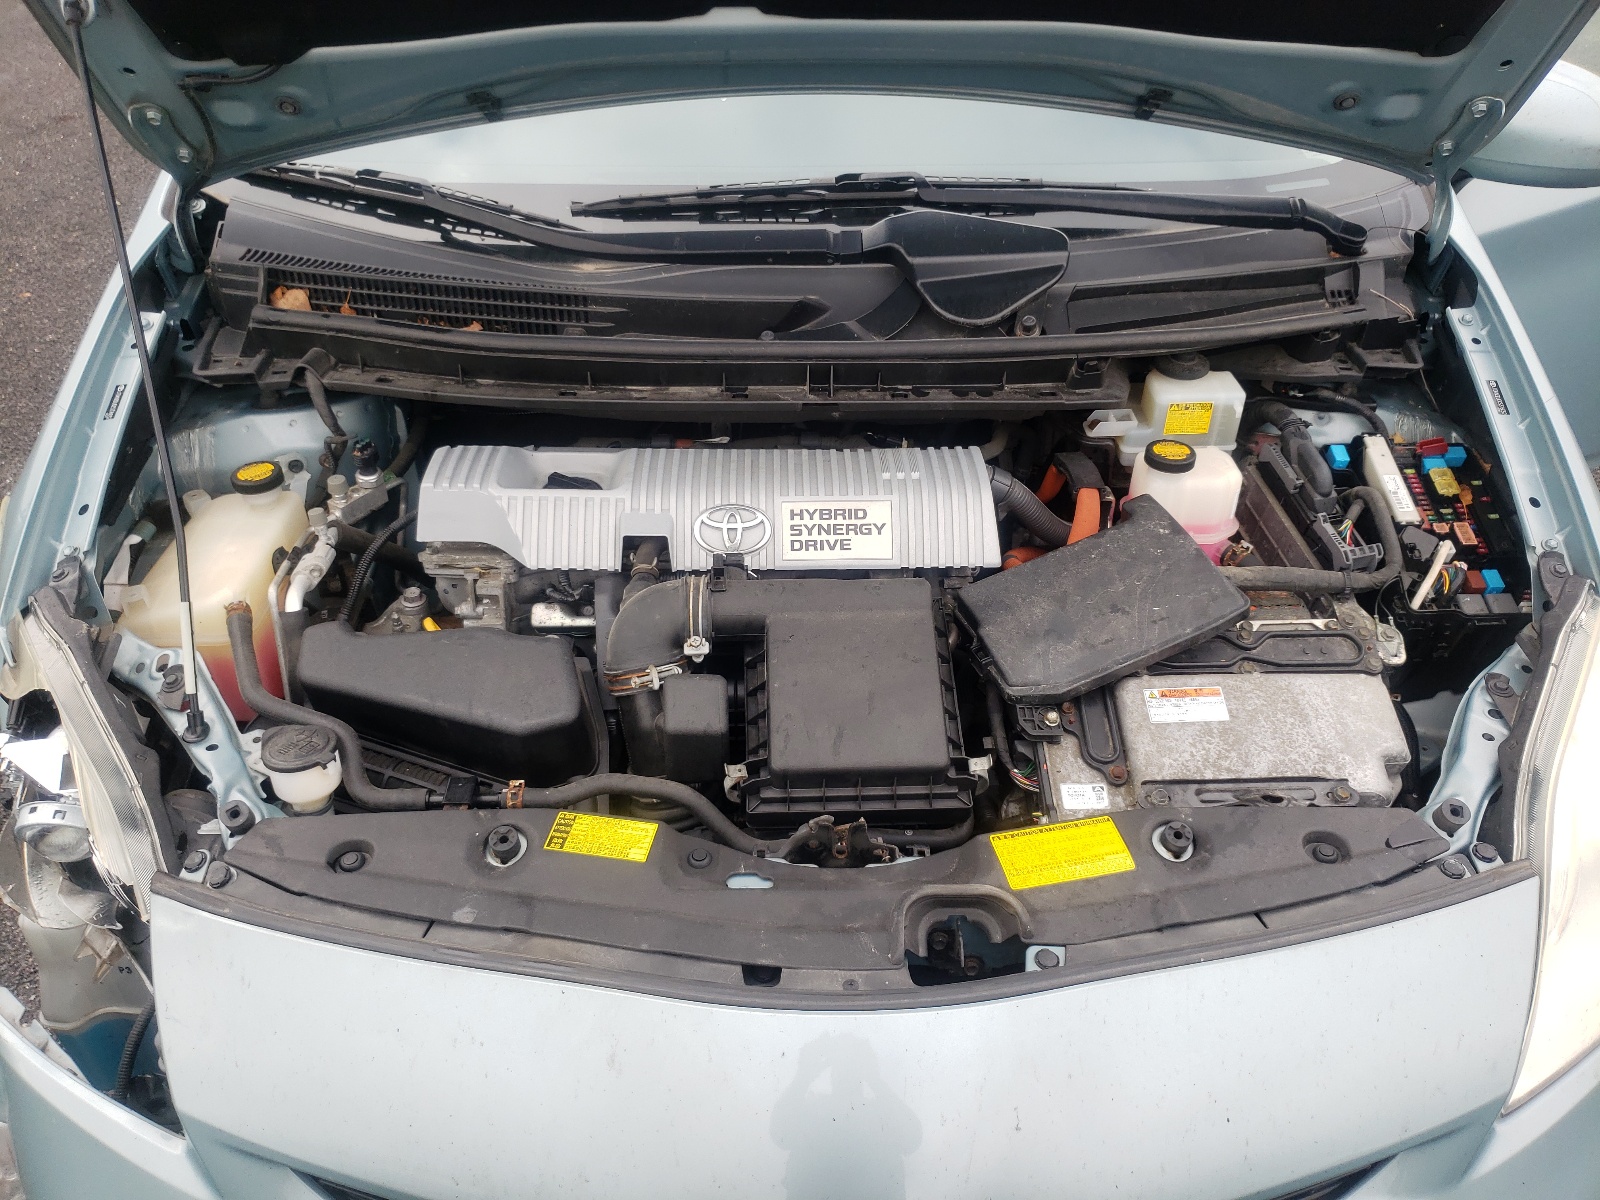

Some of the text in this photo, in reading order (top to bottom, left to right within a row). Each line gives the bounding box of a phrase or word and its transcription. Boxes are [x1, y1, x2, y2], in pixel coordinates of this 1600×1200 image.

[790, 509, 867, 520] HYBRID
[790, 523, 886, 536] SYNERGY
[790, 539, 852, 551] DRIVE
